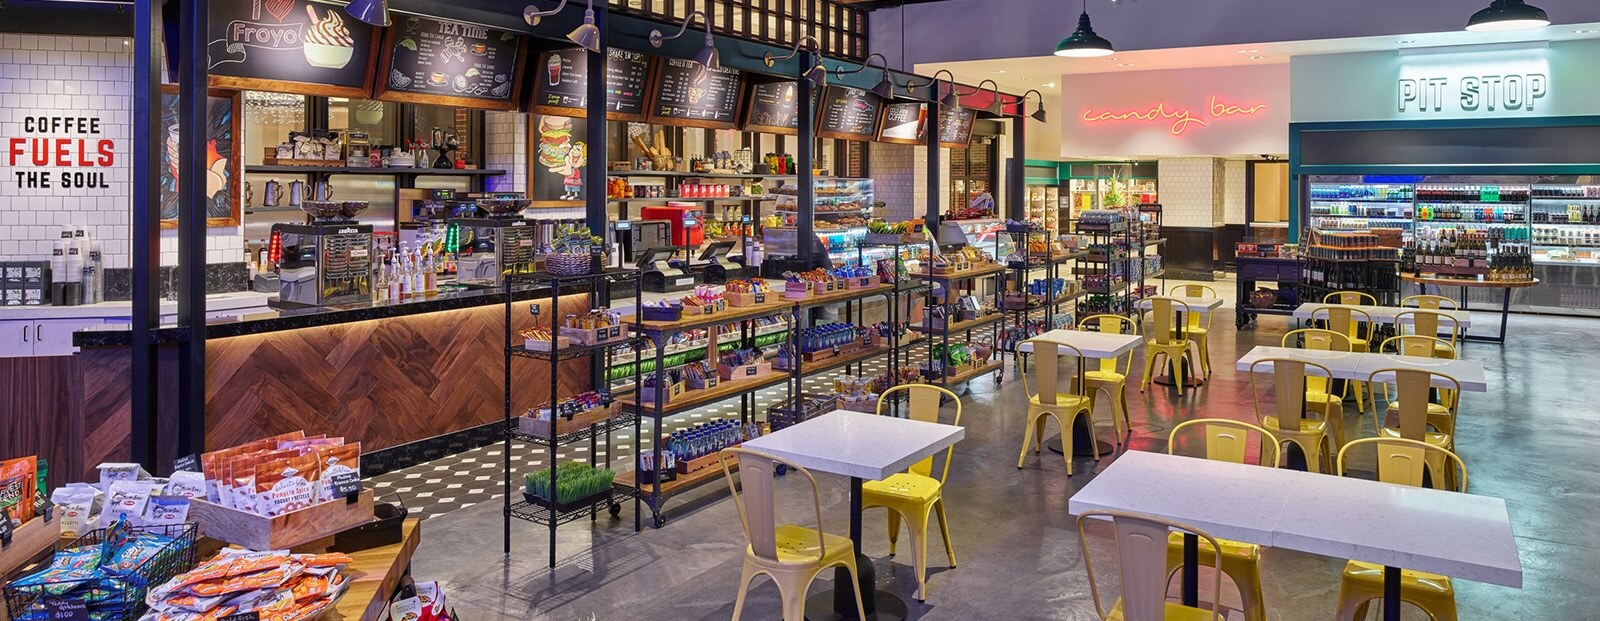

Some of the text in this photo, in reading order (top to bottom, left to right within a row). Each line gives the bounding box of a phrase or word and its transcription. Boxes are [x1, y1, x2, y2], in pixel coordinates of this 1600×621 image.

[233, 23, 298, 47] Froyo
[438, 21, 489, 39] TEA TIME
[1398, 73, 1546, 112] PIT STOP
[1083, 95, 1266, 135] candy bar
[24, 116, 100, 134] COFFEE
[9, 138, 114, 167] FUELS
[15, 171, 109, 189] THE SOUL
[271, 488, 295, 499] Pumpkin
[296, 486, 309, 495] Spice
[274, 493, 310, 505] YOGURT PRETZELS
